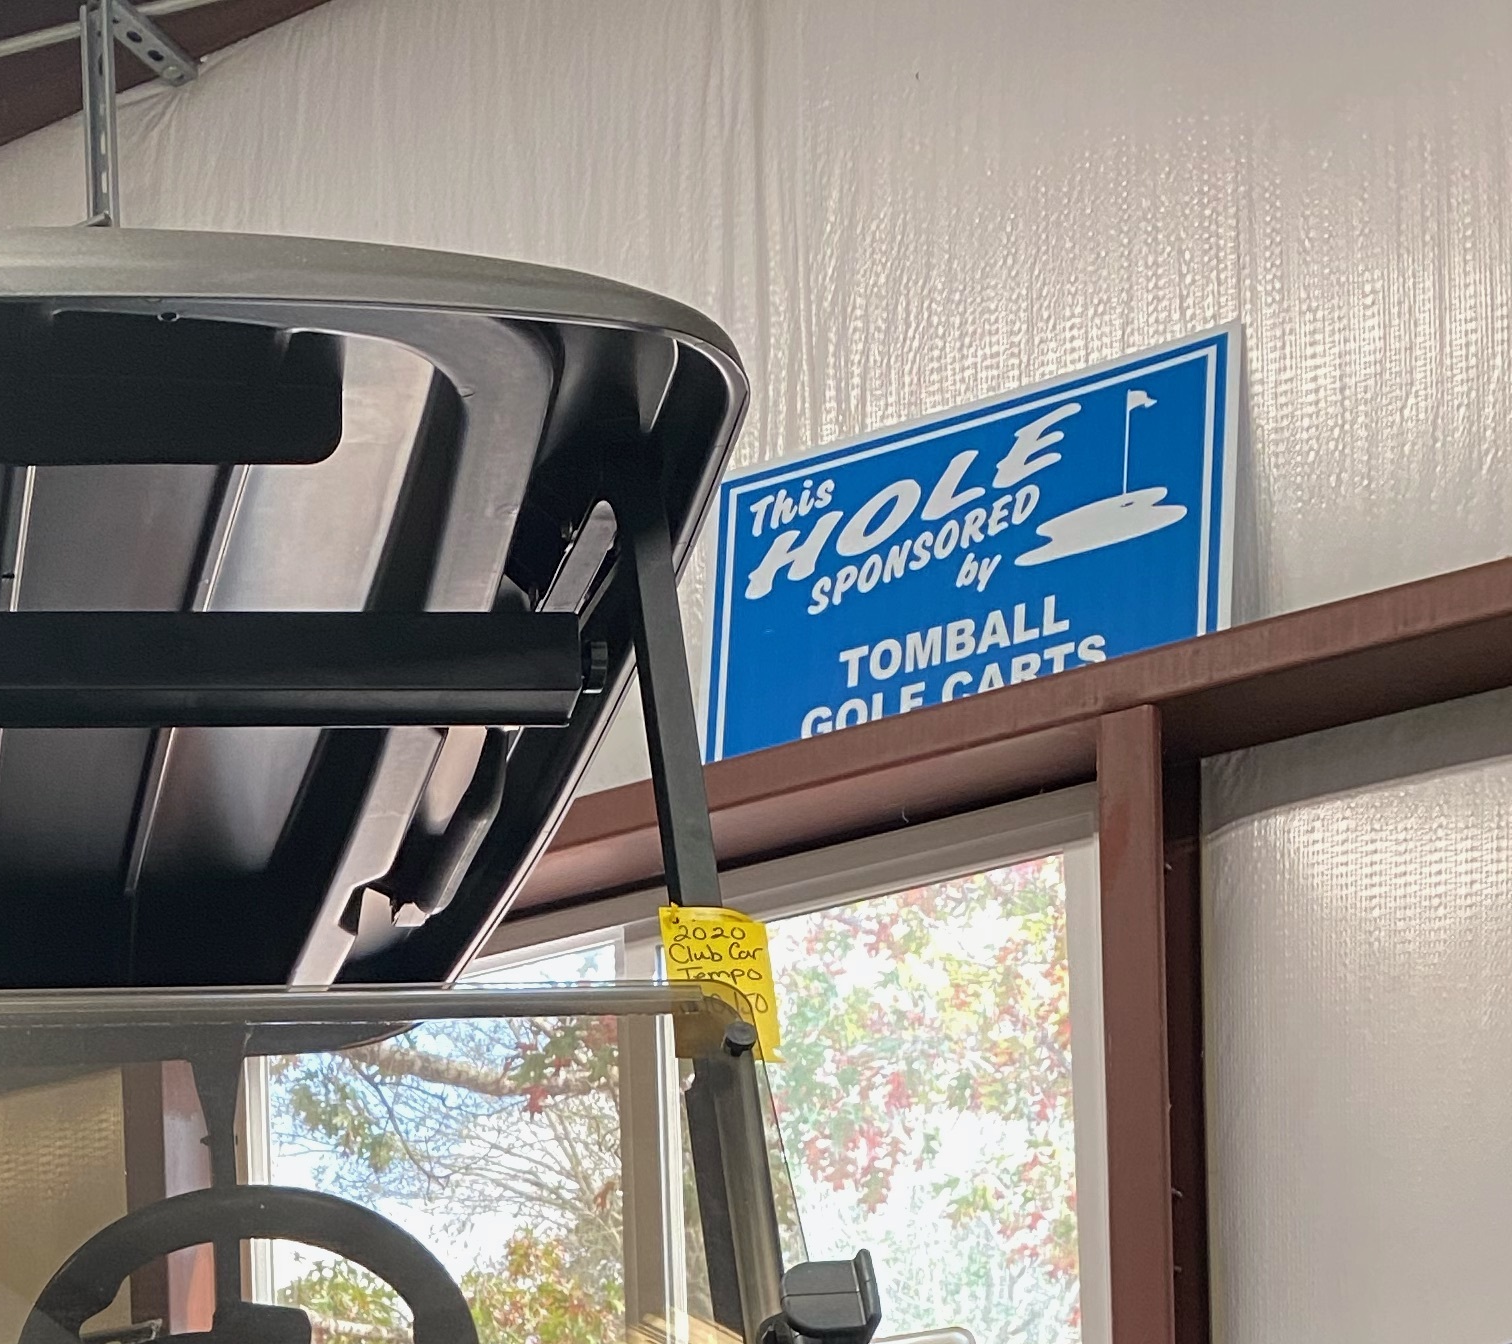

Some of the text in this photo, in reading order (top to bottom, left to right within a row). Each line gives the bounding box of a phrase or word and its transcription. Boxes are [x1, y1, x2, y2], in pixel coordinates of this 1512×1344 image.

[745, 402, 1081, 599] HOLE
[750, 479, 835, 537] This
[807, 484, 1040, 615] SPONSORED
[956, 553, 1002, 592] by
[839, 595, 1070, 688] TOMBALL
[941, 634, 1107, 703] CARTS
[668, 941, 763, 964] Club Car
[673, 925, 746, 942] 2020
[677, 966, 763, 985] Tempo
